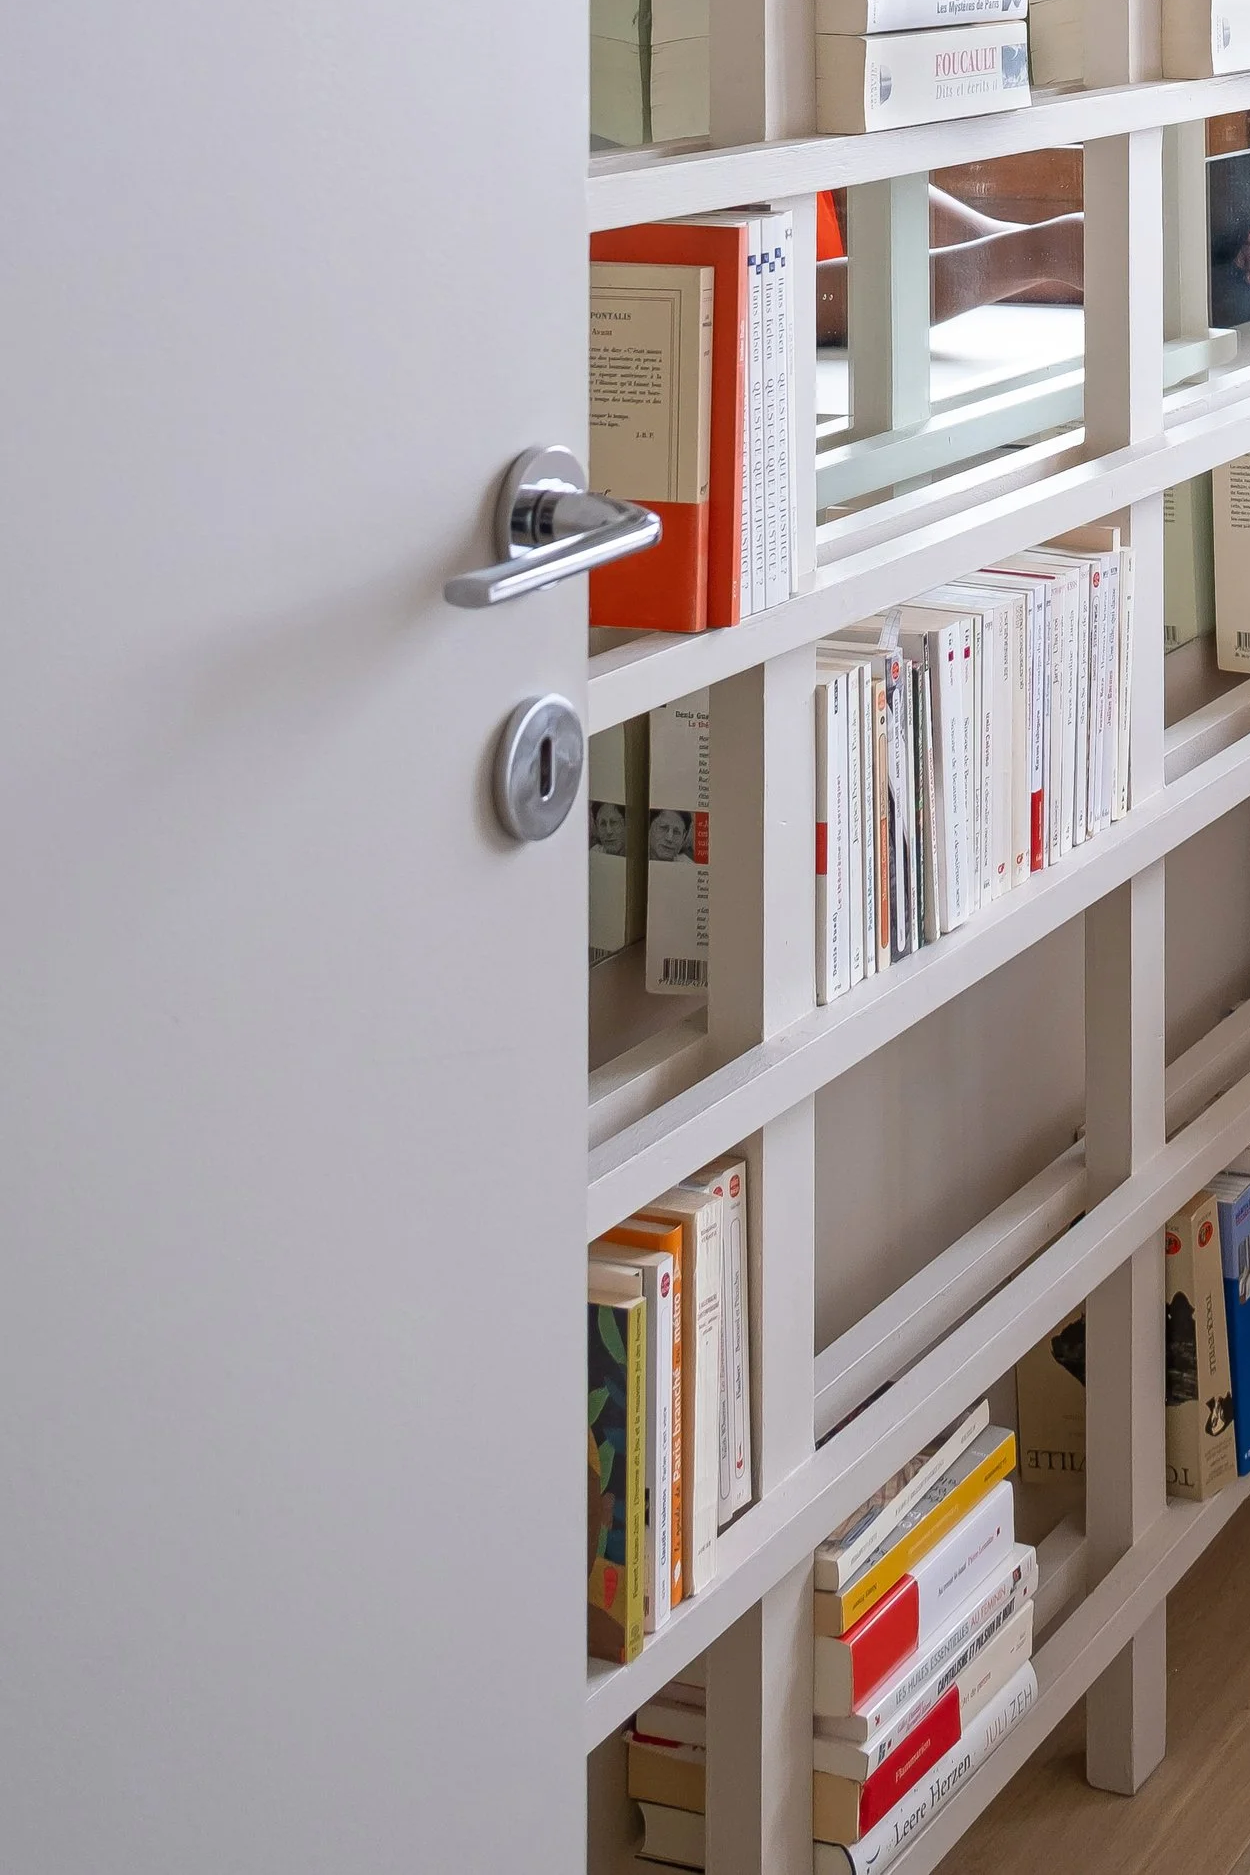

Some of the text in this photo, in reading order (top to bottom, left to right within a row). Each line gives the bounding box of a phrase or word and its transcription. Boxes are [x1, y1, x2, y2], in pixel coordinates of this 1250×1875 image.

[936, 1, 947, 14] Les
[948, 0, 976, 15] Mystères
[976, 0, 984, 10] de
[935, 46, 997, 78] FOUCAULT
[935, 83, 953, 100] Dits
[956, 82, 964, 96] et
[967, 80, 990, 95] écrits
[753, 285, 761, 316] Hans
[765, 282, 774, 313] Hans
[778, 277, 786, 309] Hans
[591, 312, 632, 321] PONTALIS
[591, 328, 613, 336] Avant
[777, 313, 786, 355] Kelsen
[753, 321, 762, 363] Kelsen
[766, 318, 775, 360] Kelsen
[752, 381, 762, 456] QU'EST-CE
[766, 378, 775, 453] QU'EST-CE
[778, 373, 787, 447] QU'EST-CE
[753, 460, 762, 491] QUE
[766, 457, 776, 487] QUE
[778, 451, 787, 481] QUE
[754, 495, 763, 514] LA
[767, 491, 776, 510] LA
[780, 485, 787, 503] LA
[754, 517, 763, 575] JUSTICE
[767, 514, 777, 571] JUSTICE
[779, 507, 788, 564] JUSTICE
[1052, 663, 1060, 686] Jarry
[834, 775, 844, 911] Le théorème du perroquet
[851, 802, 860, 845] Jacques
[831, 911, 840, 942] Guedj
[671, 1293, 681, 1345] métro
[1205, 1293, 1217, 1376] TOCQUEVILLE
[671, 1368, 682, 1436] branché
[671, 1438, 682, 1484] Paris
[660, 1489, 668, 1529] Halmos
[659, 1531, 668, 1567] Claude
[895, 1588, 1007, 1706] LES HUILES ESSENTIELLES AU FÉMININ
[937, 1649, 970, 1696] CAPITALISME
[976, 1620, 998, 1651] PULSION
[997, 1611, 1004, 1628] DE
[1003, 1596, 1016, 1621] MORT
[983, 1682, 1033, 1752] JULI ZEH
[895, 1737, 932, 1784] Flammarion
[893, 1751, 971, 1846] Leere Herzen
